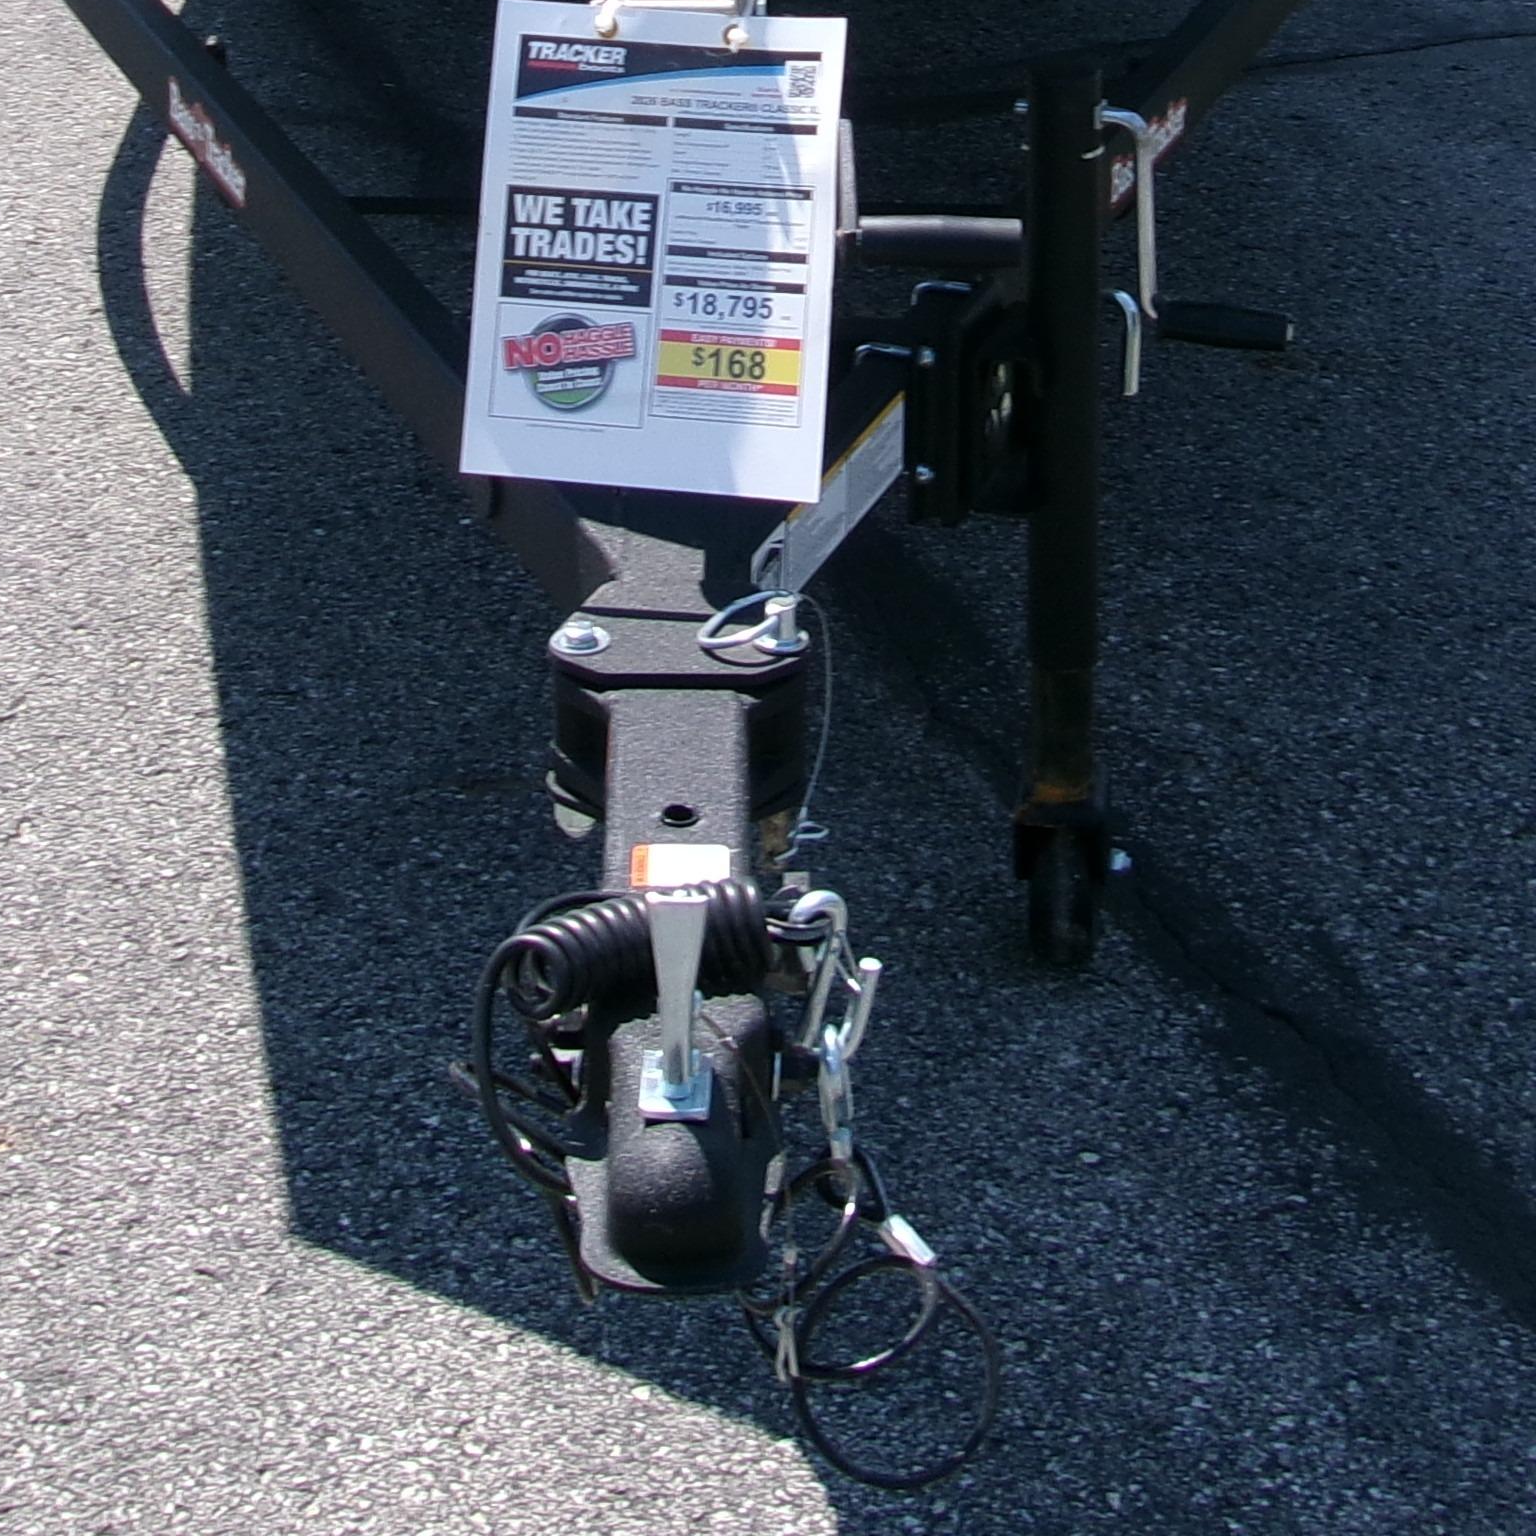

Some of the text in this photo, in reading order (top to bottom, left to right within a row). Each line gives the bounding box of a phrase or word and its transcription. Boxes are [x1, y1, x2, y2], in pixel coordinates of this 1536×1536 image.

[528, 41, 627, 65] TRACKER
[513, 194, 652, 232] WE TAKE
[510, 227, 648, 265] TRADES!
[673, 292, 773, 321] $18,795
[503, 332, 561, 371] NO
[563, 340, 634, 362] HASSLE
[691, 347, 766, 380] $168
